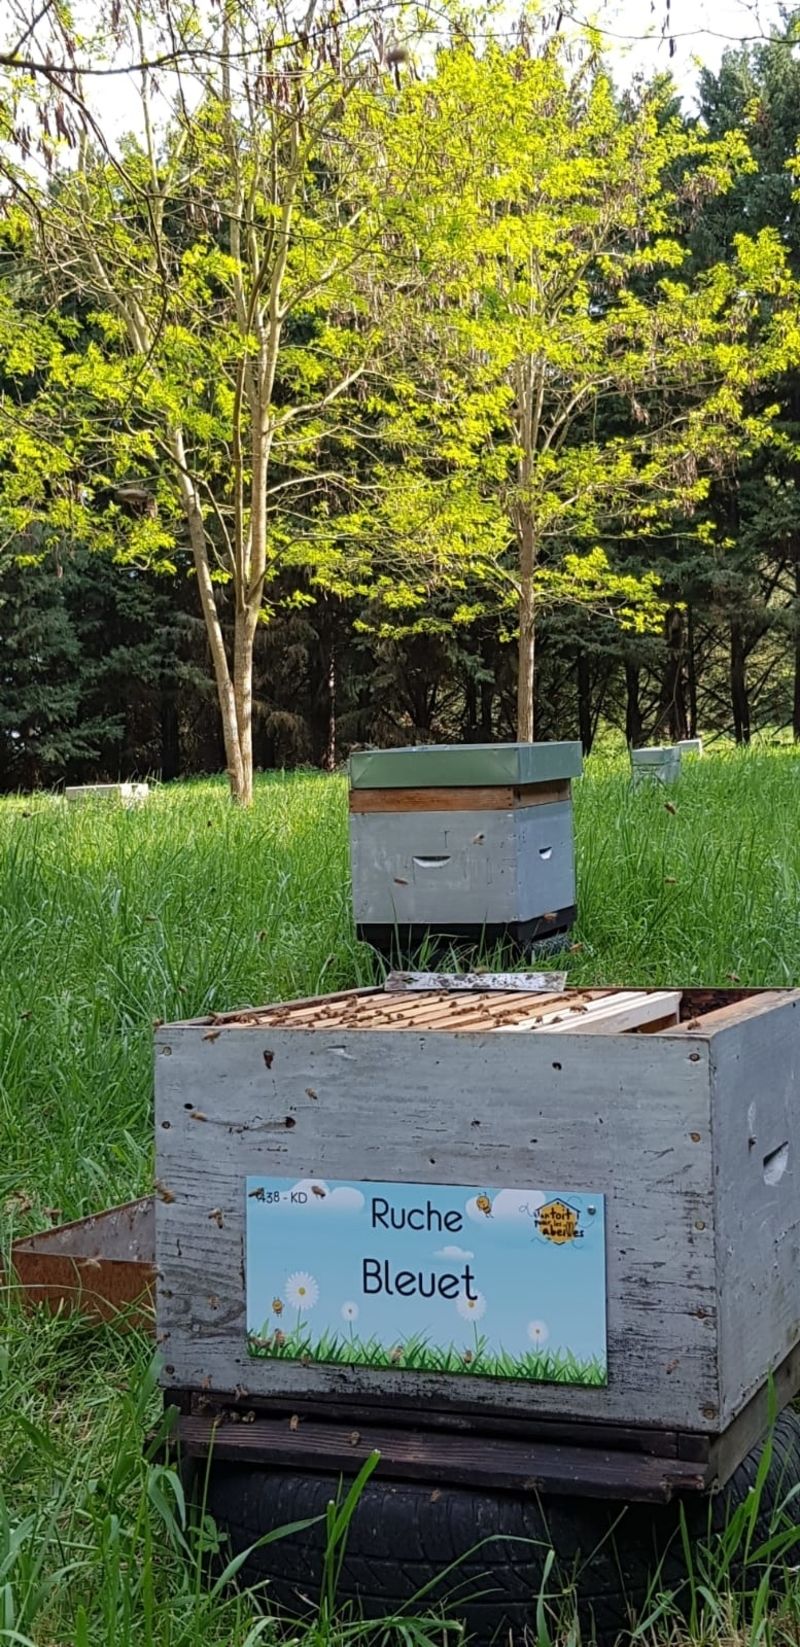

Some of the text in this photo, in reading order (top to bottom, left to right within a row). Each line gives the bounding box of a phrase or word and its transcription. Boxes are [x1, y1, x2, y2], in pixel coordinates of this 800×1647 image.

[290, 1191, 308, 1204] KD
[372, 1197, 463, 1232] Ruche
[550, 1207, 572, 1220] toit
[542, 1221, 584, 1238] abeilles
[362, 1258, 478, 1301] Bleuet
